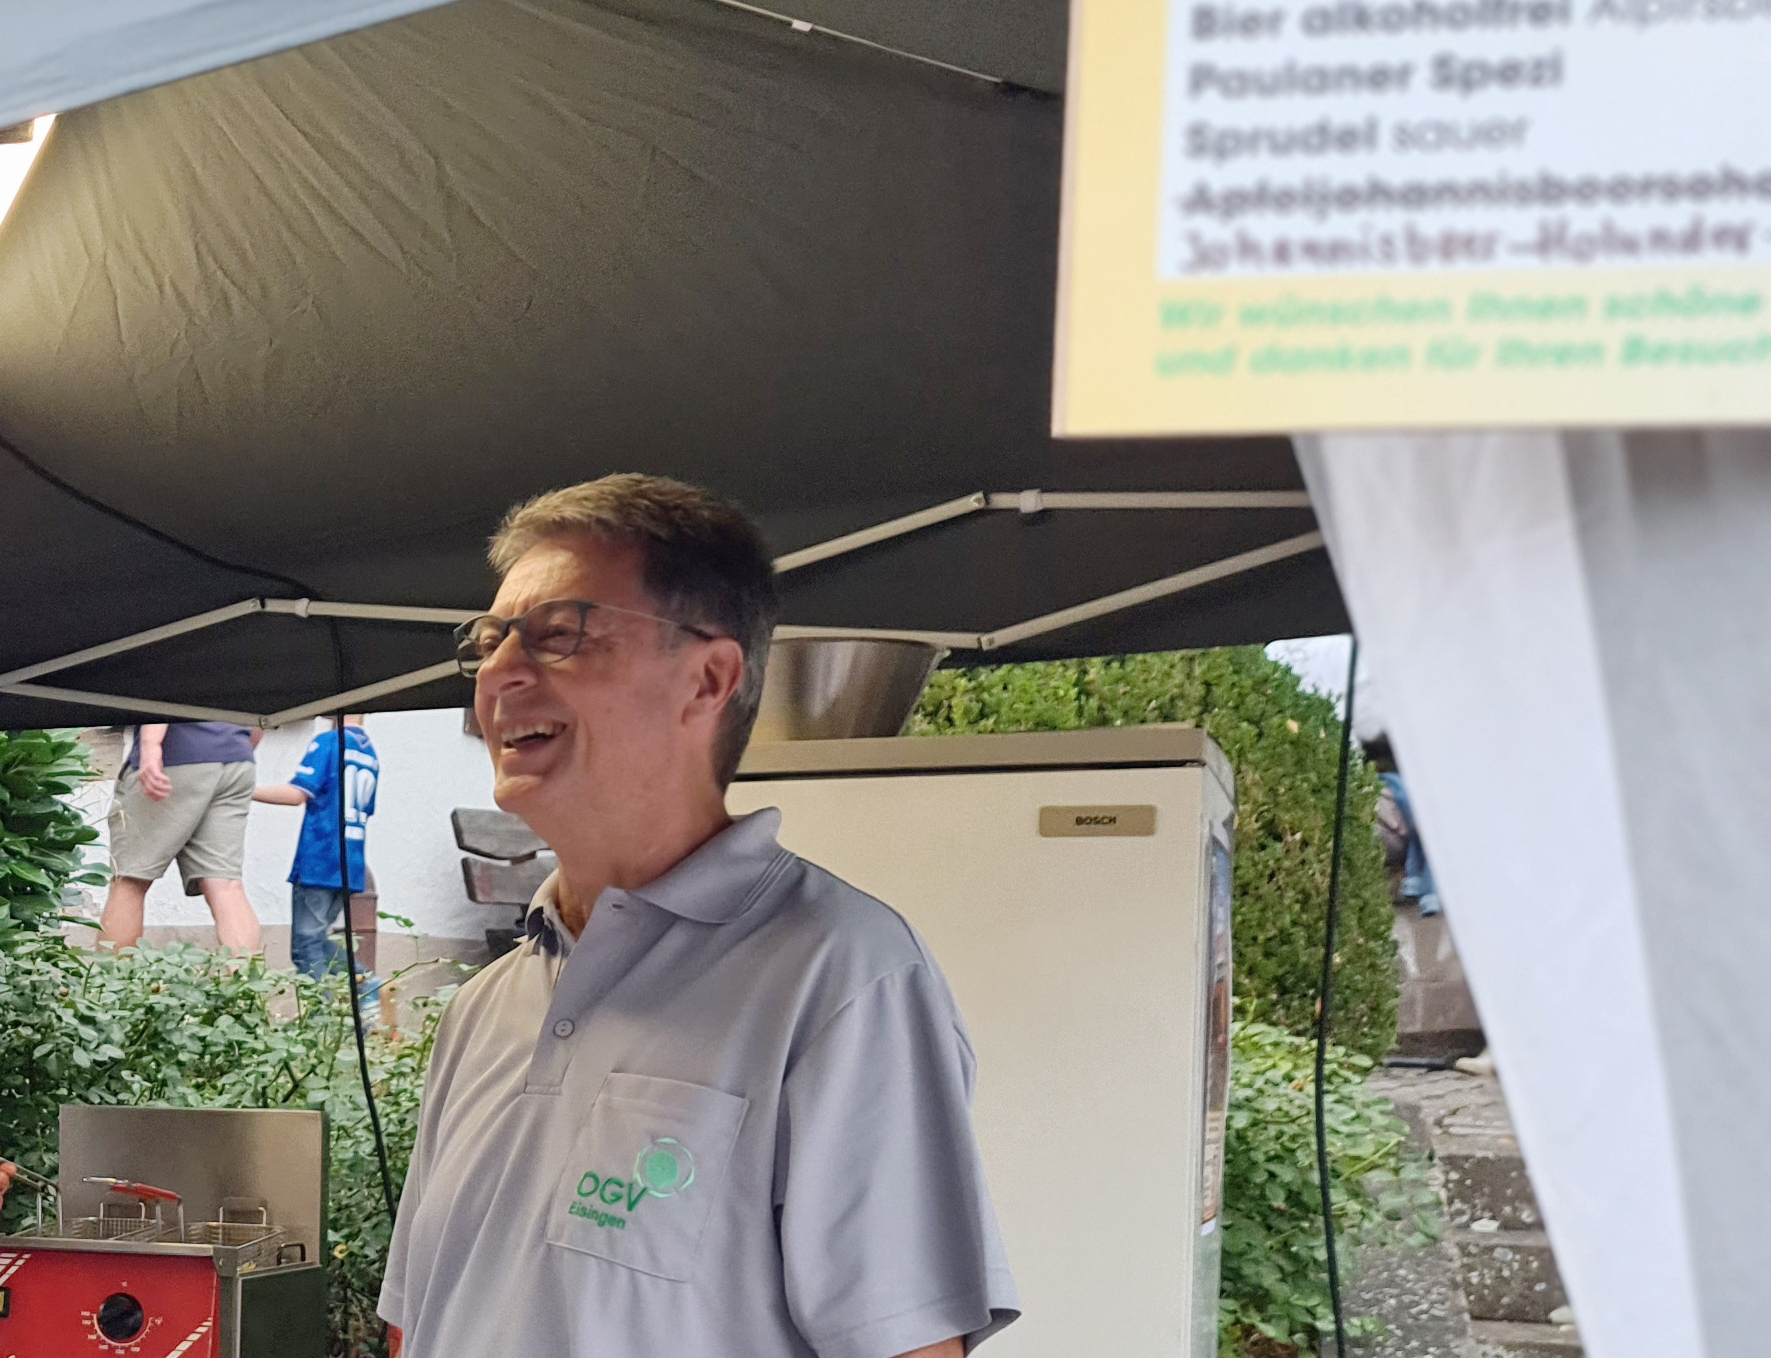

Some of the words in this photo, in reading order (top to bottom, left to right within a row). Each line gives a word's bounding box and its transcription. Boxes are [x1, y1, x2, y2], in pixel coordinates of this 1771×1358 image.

[1191, 4, 1284, 40] Bier
[1300, 0, 1571, 36] alkoholfrei
[1188, 58, 1414, 99] Paulaner
[1430, 47, 1564, 98] Spezi
[1184, 113, 1378, 167] Sprudel
[1393, 116, 1528, 152] sauer
[1160, 297, 1223, 328] Wir
[1238, 291, 1451, 328] wünschen
[1468, 289, 1588, 323] Ihnen
[1154, 340, 1236, 378] und
[1249, 340, 1412, 375] danken
[1425, 335, 1481, 371] für
[1495, 336, 1604, 371] Ihren
[1075, 816, 1117, 826] BOSCH
[577, 1171, 648, 1212] OGV
